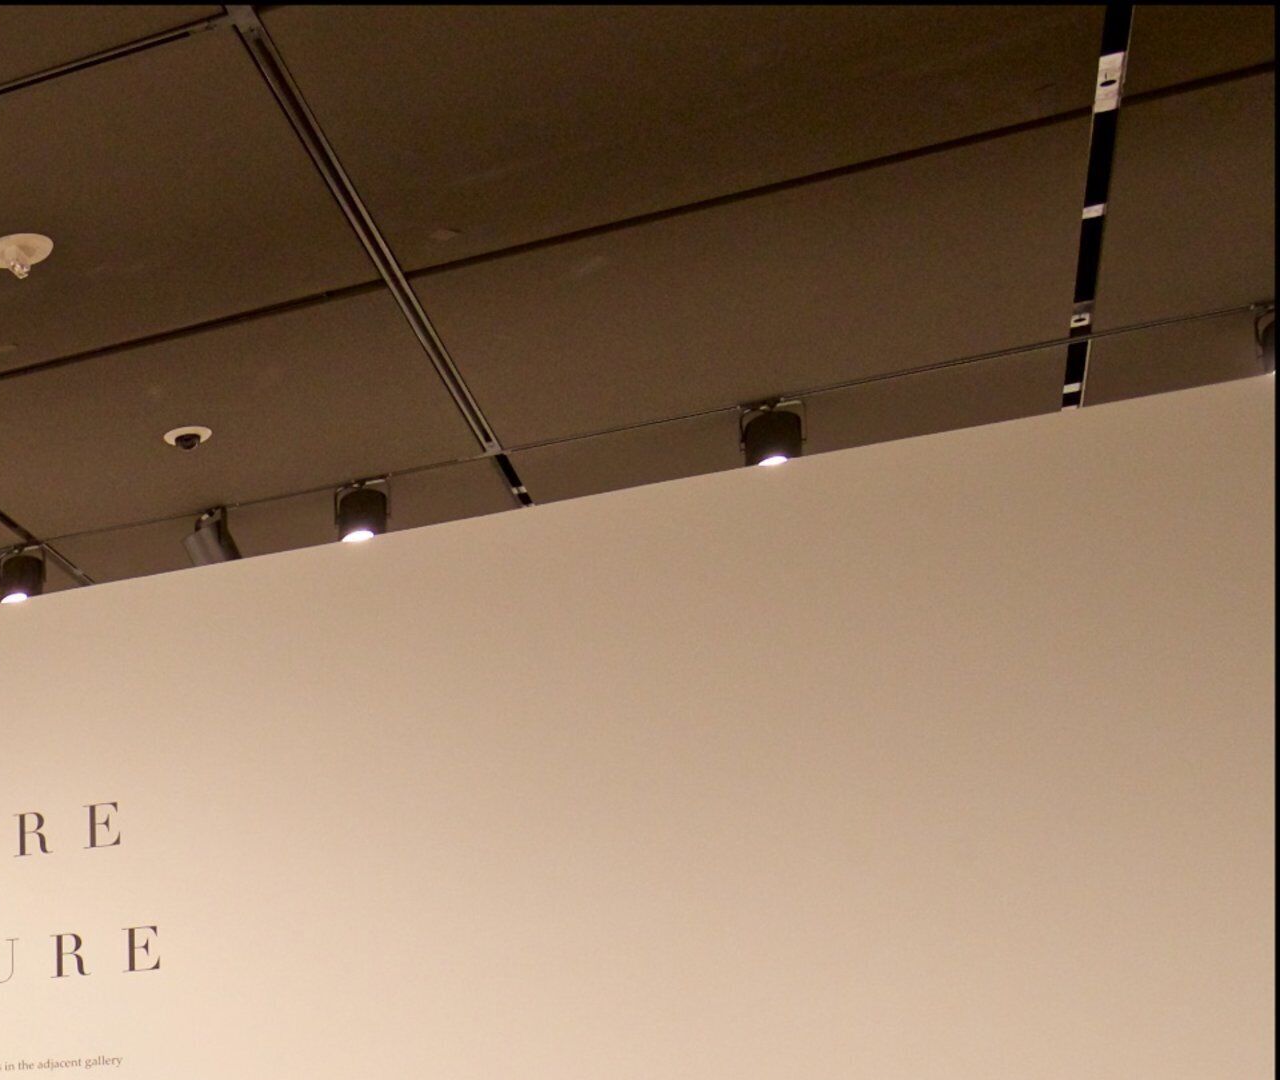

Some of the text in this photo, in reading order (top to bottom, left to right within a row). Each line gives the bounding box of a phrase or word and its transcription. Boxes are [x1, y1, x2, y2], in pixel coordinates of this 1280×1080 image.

[5, 1062, 15, 1071] in
[18, 1060, 34, 1070] the
[37, 1059, 81, 1071] adjacent
[85, 1055, 123, 1069] gallery
